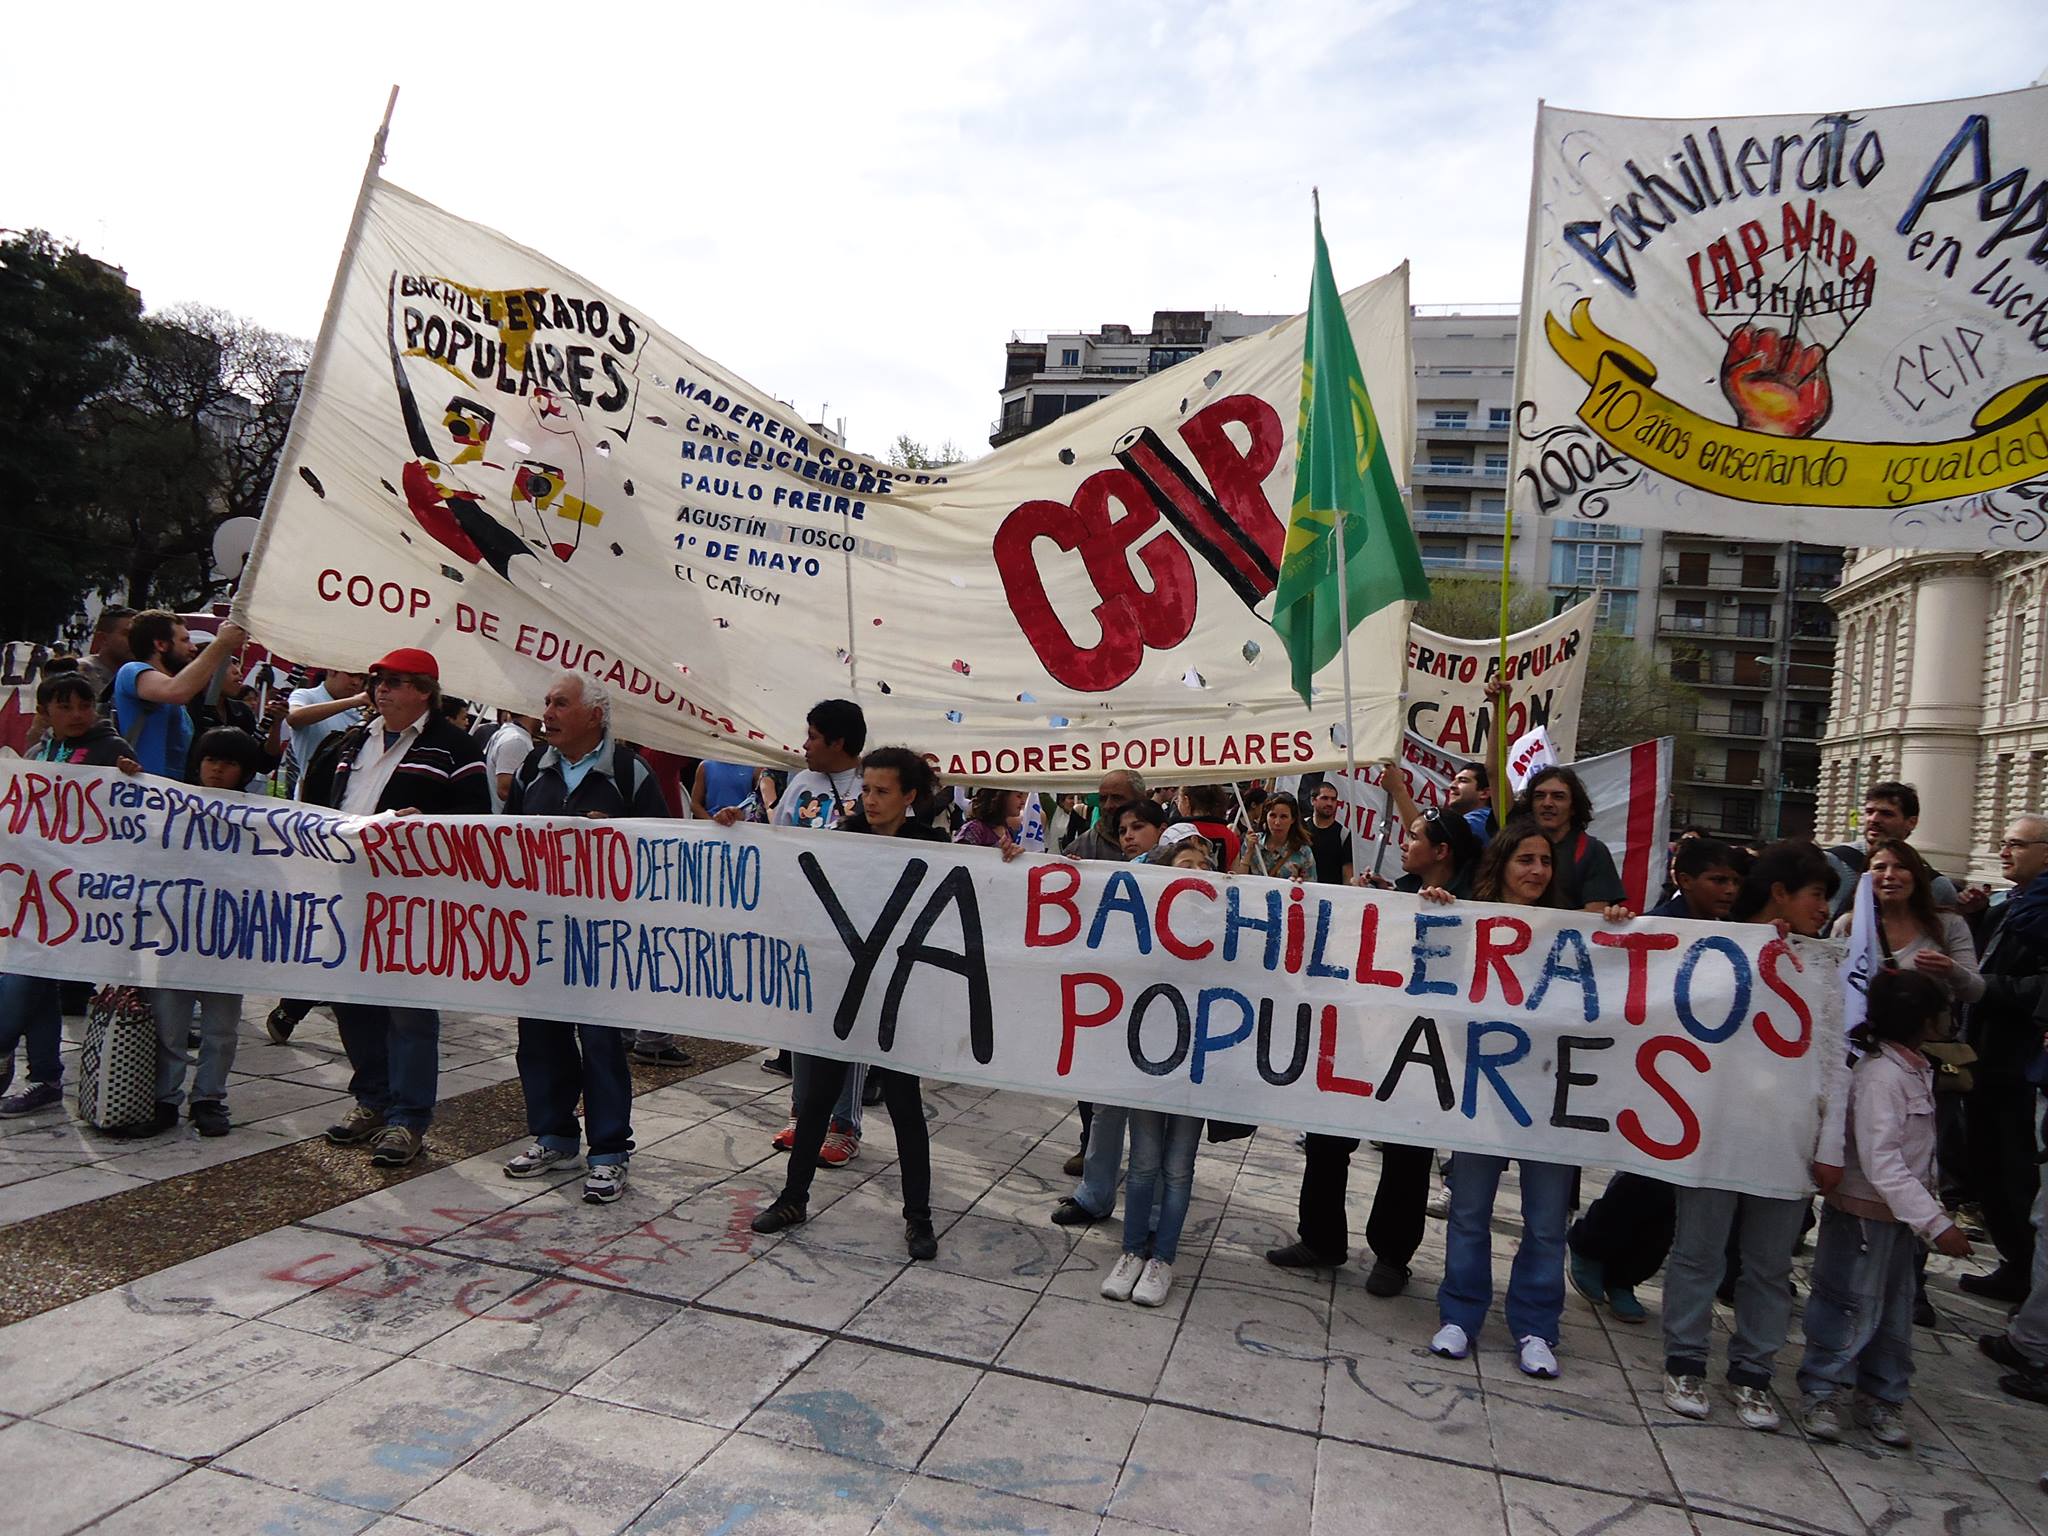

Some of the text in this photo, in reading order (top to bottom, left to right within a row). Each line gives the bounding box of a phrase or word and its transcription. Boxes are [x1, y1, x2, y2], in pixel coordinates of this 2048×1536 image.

[1908, 231, 1962, 278] en
[401, 274, 640, 355] BACHILLERATOS
[404, 305, 630, 412] POPULARES
[674, 377, 949, 485] MADERERA CORDOBA
[1591, 380, 1643, 432] 10
[1633, 412, 1693, 460] años
[1698, 438, 1847, 488] enseñando
[749, 440, 893, 496] DICIEMBRE
[1517, 440, 1631, 515] 2004
[680, 472, 866, 521] PAULO FREIRE
[676, 505, 767, 538] AGUSTÍN
[787, 524, 856, 552] TOSCO
[673, 563, 698, 585] EL
[704, 540, 741, 563] DE
[748, 549, 820, 577] MAYO
[455, 601, 500, 642] DE
[1407, 628, 1581, 684] ERATO POPULAR
[1101, 729, 1315, 770] POPULARES
[109, 814, 147, 844] LOS
[162, 787, 356, 864] PROFESORES
[81, 911, 124, 946] LOS
[360, 891, 531, 986] RECURSOS
[536, 919, 554, 965] E
[797, 850, 994, 1065] YA
[1056, 973, 1712, 1161] POPULARES
